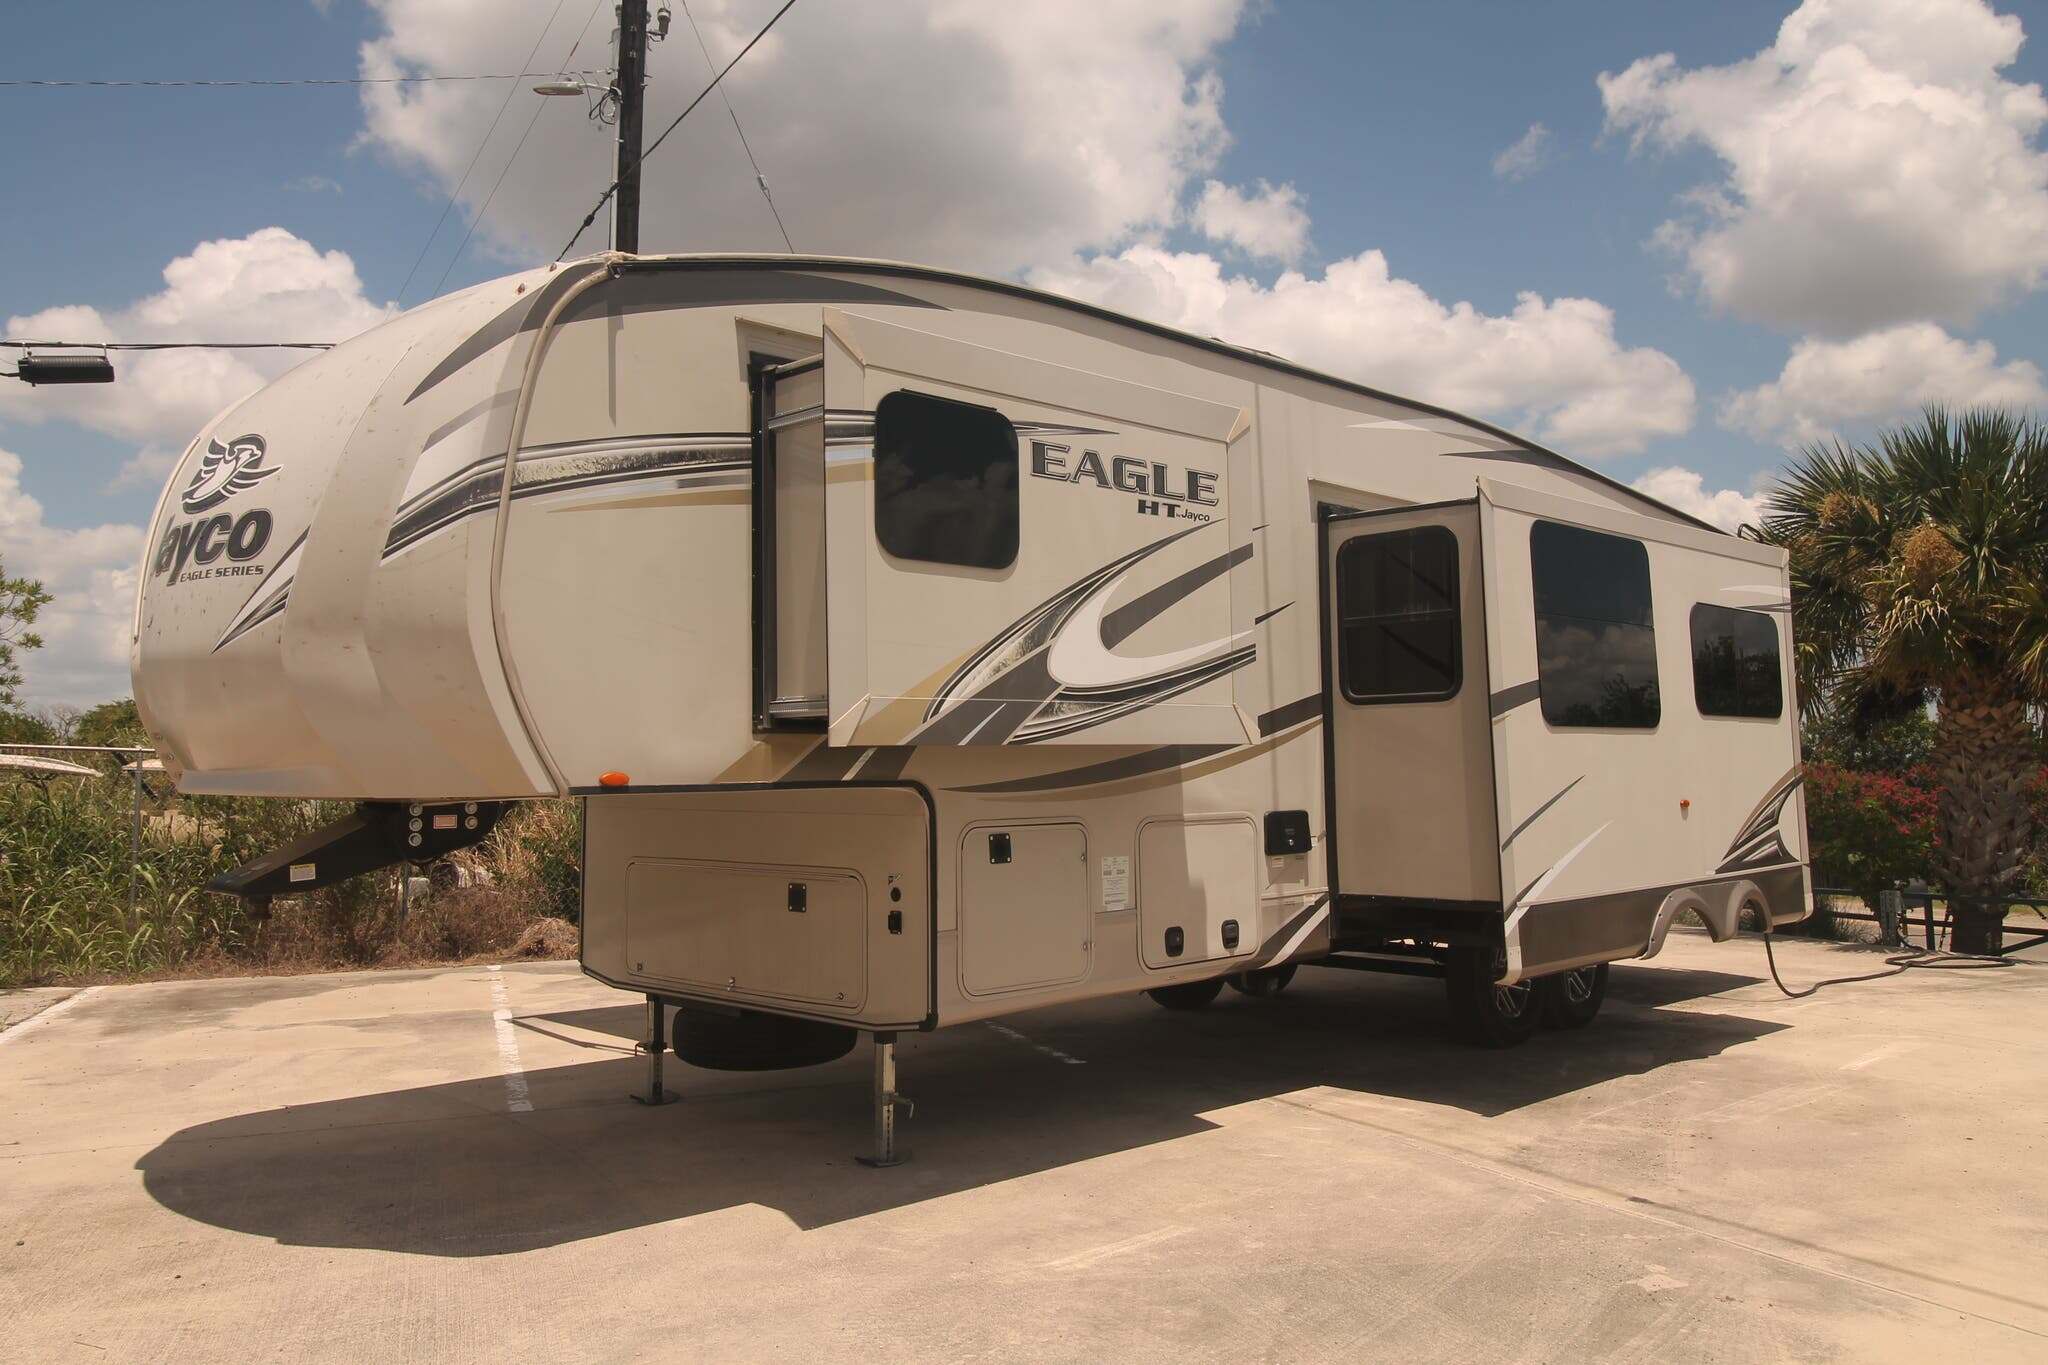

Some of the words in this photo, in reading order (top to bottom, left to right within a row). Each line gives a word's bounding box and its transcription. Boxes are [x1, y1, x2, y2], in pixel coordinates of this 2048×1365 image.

[1030, 439, 1219, 506] EAGLE
[1137, 499, 1181, 518] HT
[1181, 508, 1210, 522] Jayco
[180, 568, 213, 582] EAGLE
[214, 565, 264, 578] SERIES
